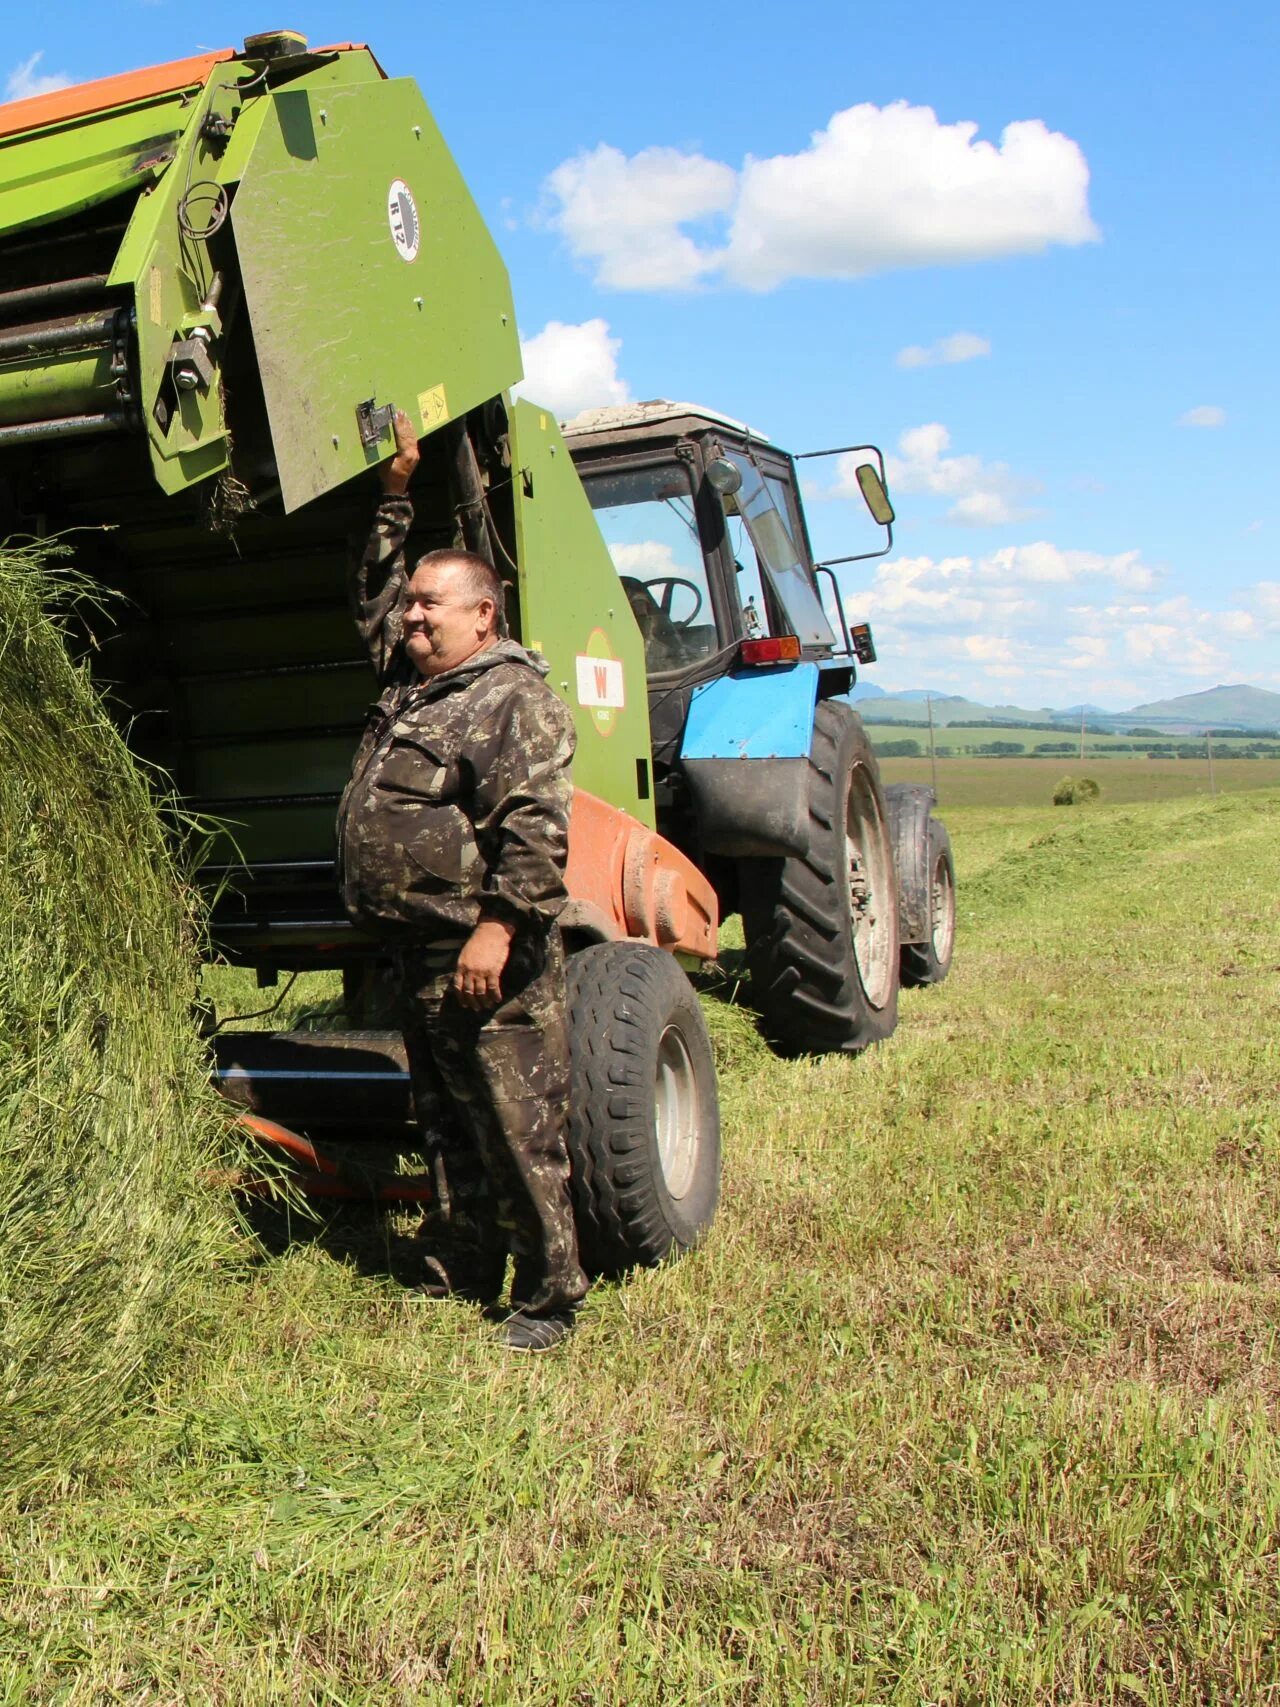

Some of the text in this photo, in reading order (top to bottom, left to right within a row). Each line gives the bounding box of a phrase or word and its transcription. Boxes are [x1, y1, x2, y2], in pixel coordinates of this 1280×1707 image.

[390, 202, 405, 244] R 12
[594, 665, 607, 699] W
